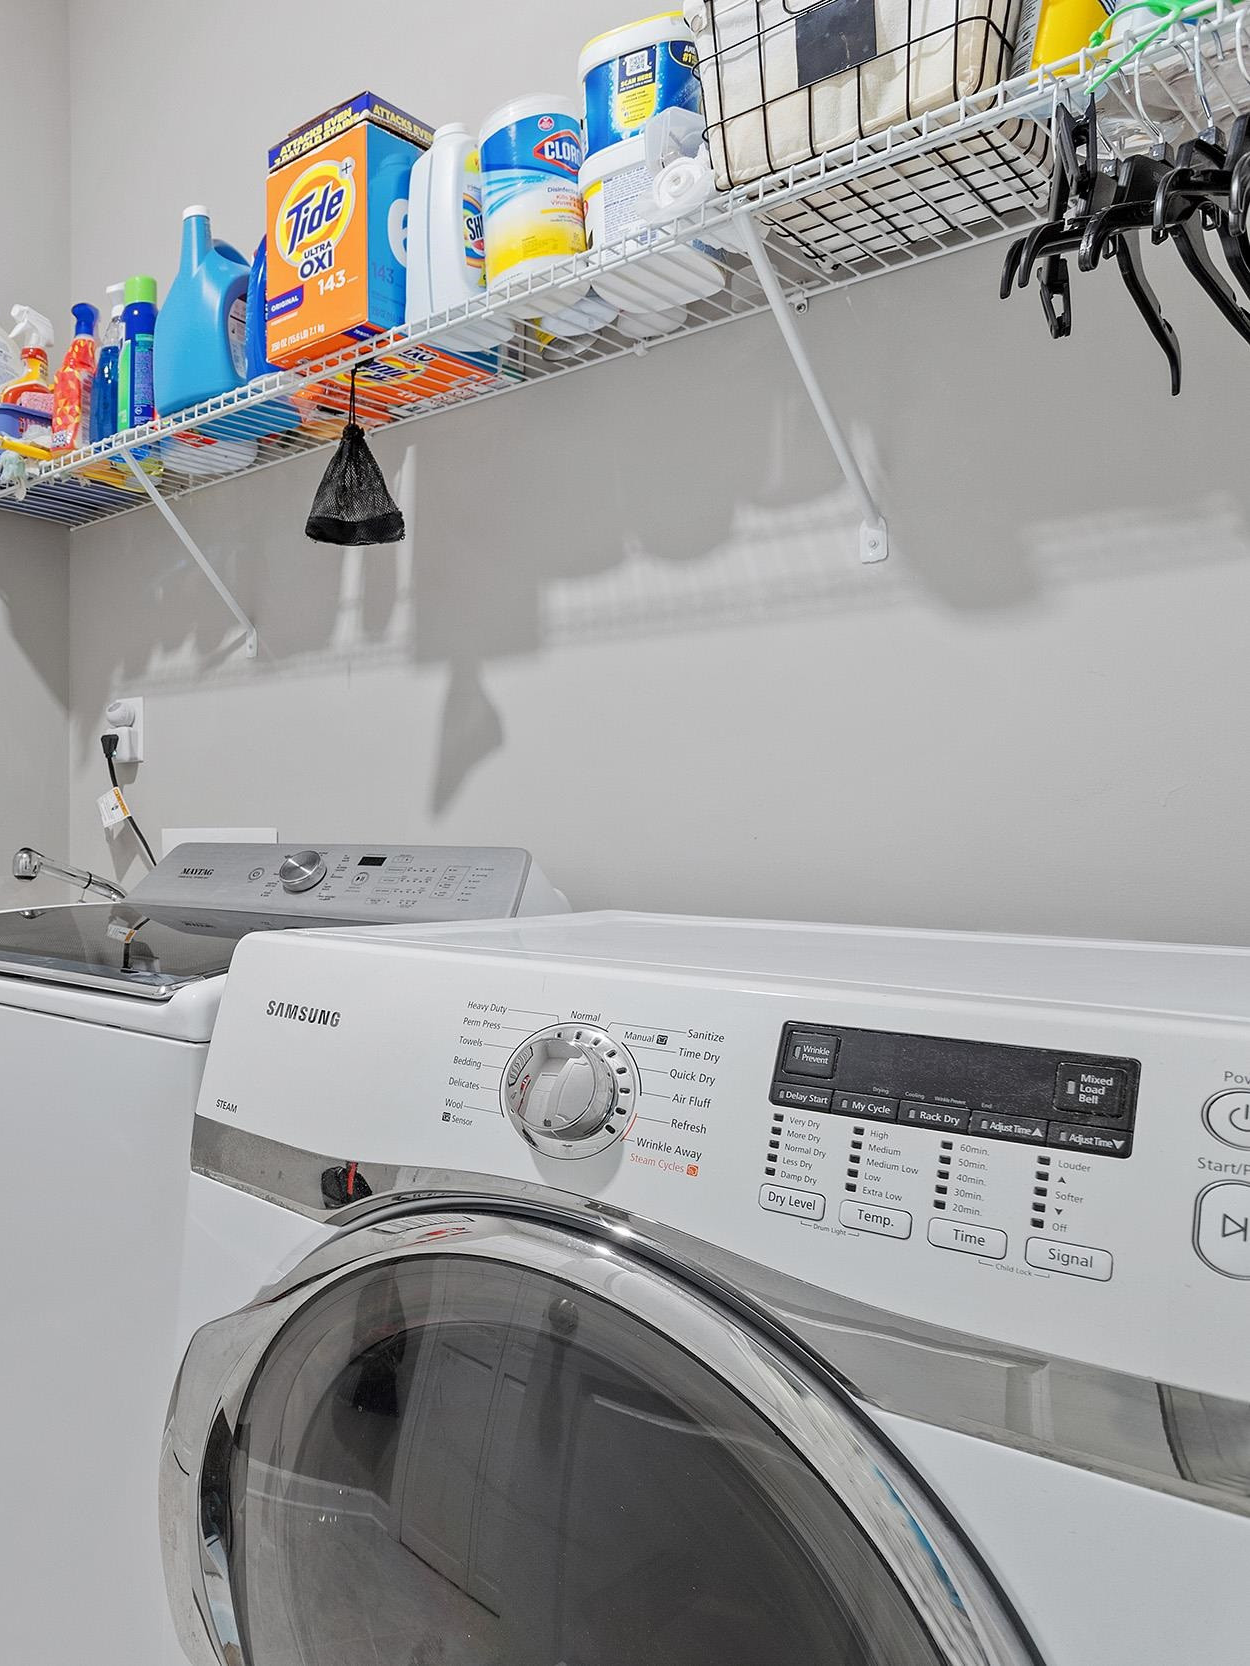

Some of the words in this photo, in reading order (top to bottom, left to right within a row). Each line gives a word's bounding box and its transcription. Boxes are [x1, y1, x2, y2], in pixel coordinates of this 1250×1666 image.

[372, 104, 412, 132] ATTACKS
[280, 124, 322, 156] ATTACKS
[324, 106, 352, 130] EVEN
[286, 180, 345, 256] Tide
[304, 240, 332, 260] ULTRA
[300, 252, 334, 279] OXI
[318, 268, 346, 296] 143
[270, 296, 299, 312] ORIGINAL
[182, 868, 215, 876] MAYTAG
[266, 1000, 341, 1028] SAMSUNG
[467, 1001, 490, 1012] Heavy
[490, 1004, 508, 1015] Duty
[462, 1016, 481, 1026] Perm
[482, 1020, 501, 1030] Press
[570, 1010, 601, 1022] Normal
[459, 1036, 483, 1047] Towels
[624, 1032, 654, 1043] Manual
[686, 1028, 725, 1043] Sanitize
[678, 1047, 702, 1060] Time
[703, 1052, 721, 1064] Dry
[803, 1044, 830, 1056] Wrinkle
[453, 1056, 482, 1070] Bedding
[802, 1054, 828, 1065] Prevent
[448, 1076, 480, 1090] Delicates
[670, 1068, 696, 1082] Quick
[698, 1072, 716, 1087] Dry
[1080, 1074, 1114, 1086] Mixed
[872, 1086, 890, 1095] Drying
[904, 1091, 925, 1100] Cooling
[1080, 1084, 1106, 1096] Load
[445, 1098, 464, 1110] Wool
[672, 1094, 686, 1104] Air
[688, 1096, 712, 1109] Fluff
[785, 1090, 808, 1103] Delay
[808, 1094, 829, 1105] Start
[1078, 1093, 1098, 1105] Bell
[216, 1098, 238, 1114] STEAM
[852, 1101, 866, 1112] My
[868, 1103, 892, 1115] Cycle
[452, 1114, 472, 1126] Sensor
[789, 1116, 806, 1127] Very
[807, 1119, 821, 1130] Dry
[920, 1111, 942, 1122] Rack
[944, 1114, 961, 1126] Dry
[670, 1118, 707, 1134] Refresh
[989, 1120, 1013, 1134] Adjust
[1014, 1123, 1032, 1135] Time
[786, 1130, 806, 1140] More
[807, 1132, 822, 1144] Dry
[870, 1130, 889, 1140] High
[1068, 1132, 1093, 1146] Adjust
[1093, 1137, 1113, 1148] Time
[636, 1137, 672, 1154] Wrinkle
[674, 1146, 702, 1162] Away
[784, 1143, 812, 1154] Normal
[812, 1148, 826, 1158] Dry
[868, 1144, 902, 1156] Medium
[960, 1144, 990, 1156] 60min.
[630, 1152, 656, 1166] Steam
[658, 1160, 684, 1173] Cycles
[782, 1156, 798, 1167] Less
[800, 1160, 813, 1170] Dry
[866, 1158, 900, 1170] Medium
[902, 1163, 918, 1174] Low
[958, 1158, 988, 1171] 50min.
[1058, 1160, 1091, 1172] Louder
[780, 1170, 803, 1184] Damp
[804, 1174, 818, 1186] Dry
[864, 1172, 881, 1182] Low
[956, 1174, 987, 1186] 40min.
[768, 1190, 787, 1206] Dry
[788, 1196, 816, 1211] Level
[862, 1186, 884, 1198] Extra
[885, 1190, 902, 1202] Low
[954, 1188, 984, 1201] 30min.
[1055, 1190, 1084, 1204] Softer
[952, 1203, 982, 1216] 20min.
[857, 1208, 895, 1228] Temp.
[813, 1223, 830, 1232] Drum
[831, 1226, 847, 1236] Light
[1052, 1222, 1067, 1232] Off
[953, 1228, 986, 1246] Time
[1048, 1248, 1094, 1269] Signal
[996, 1263, 1014, 1273] Child
[1015, 1266, 1032, 1277] Lock
